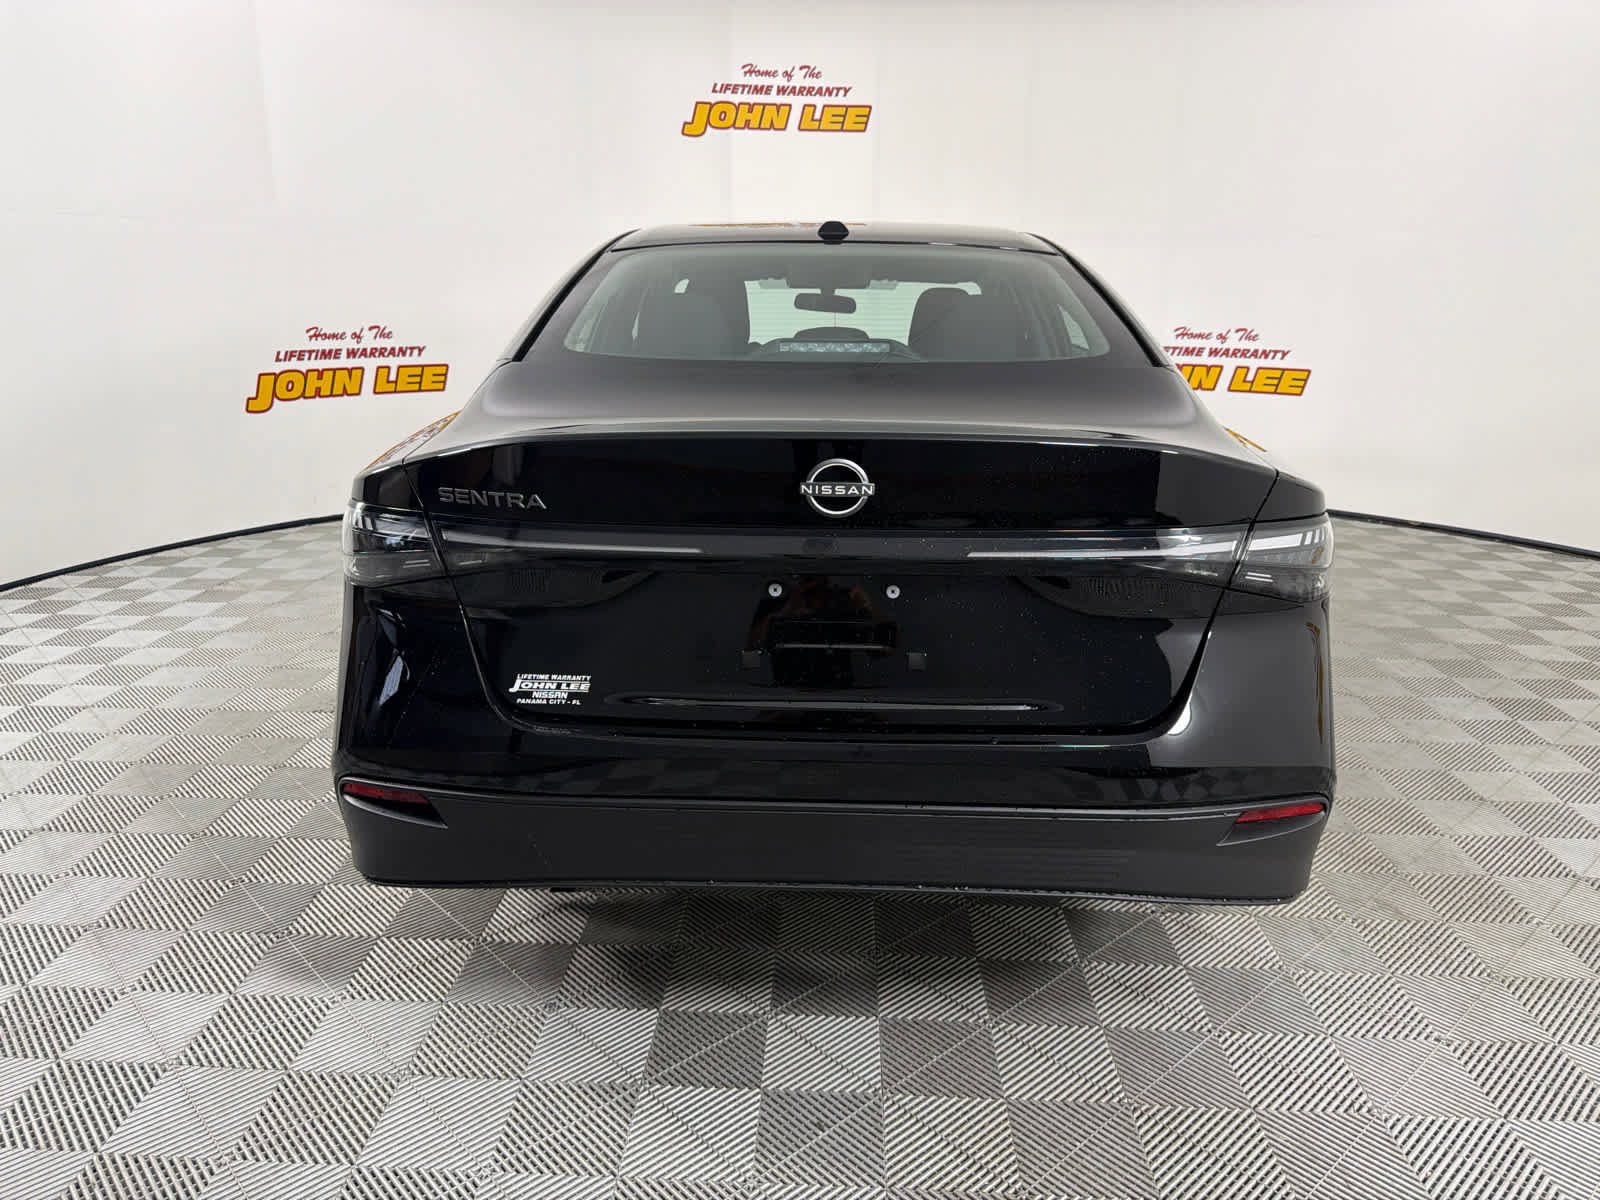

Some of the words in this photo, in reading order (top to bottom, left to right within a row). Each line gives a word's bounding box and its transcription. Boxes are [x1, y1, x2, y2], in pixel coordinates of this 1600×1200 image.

[741, 63, 778, 79] Home
[782, 66, 795, 82] of
[799, 65, 822, 80] The
[711, 83, 772, 96] LIFETIME
[776, 85, 851, 98] WARRANTY
[682, 101, 792, 137] JOHN
[798, 104, 872, 133] LEE
[305, 326, 347, 342] Home
[350, 327, 365, 344] of
[368, 325, 393, 340] The
[1173, 326, 1212, 341] Home
[1215, 329, 1231, 344] of
[1235, 328, 1260, 342] The
[274, 349, 342, 363] LIFETIME
[345, 346, 426, 359] WARRANTY
[1208, 347, 1290, 361] WARRANTY
[245, 366, 365, 414] JOHN
[373, 364, 449, 395] LEE
[1227, 365, 1312, 397] LEE
[438, 487, 547, 510] SENTRA
[801, 484, 873, 495] NISSAN
[508, 678, 557, 693] JOHN
[560, 683, 591, 692] LEE
[532, 691, 568, 699] NISSAN
